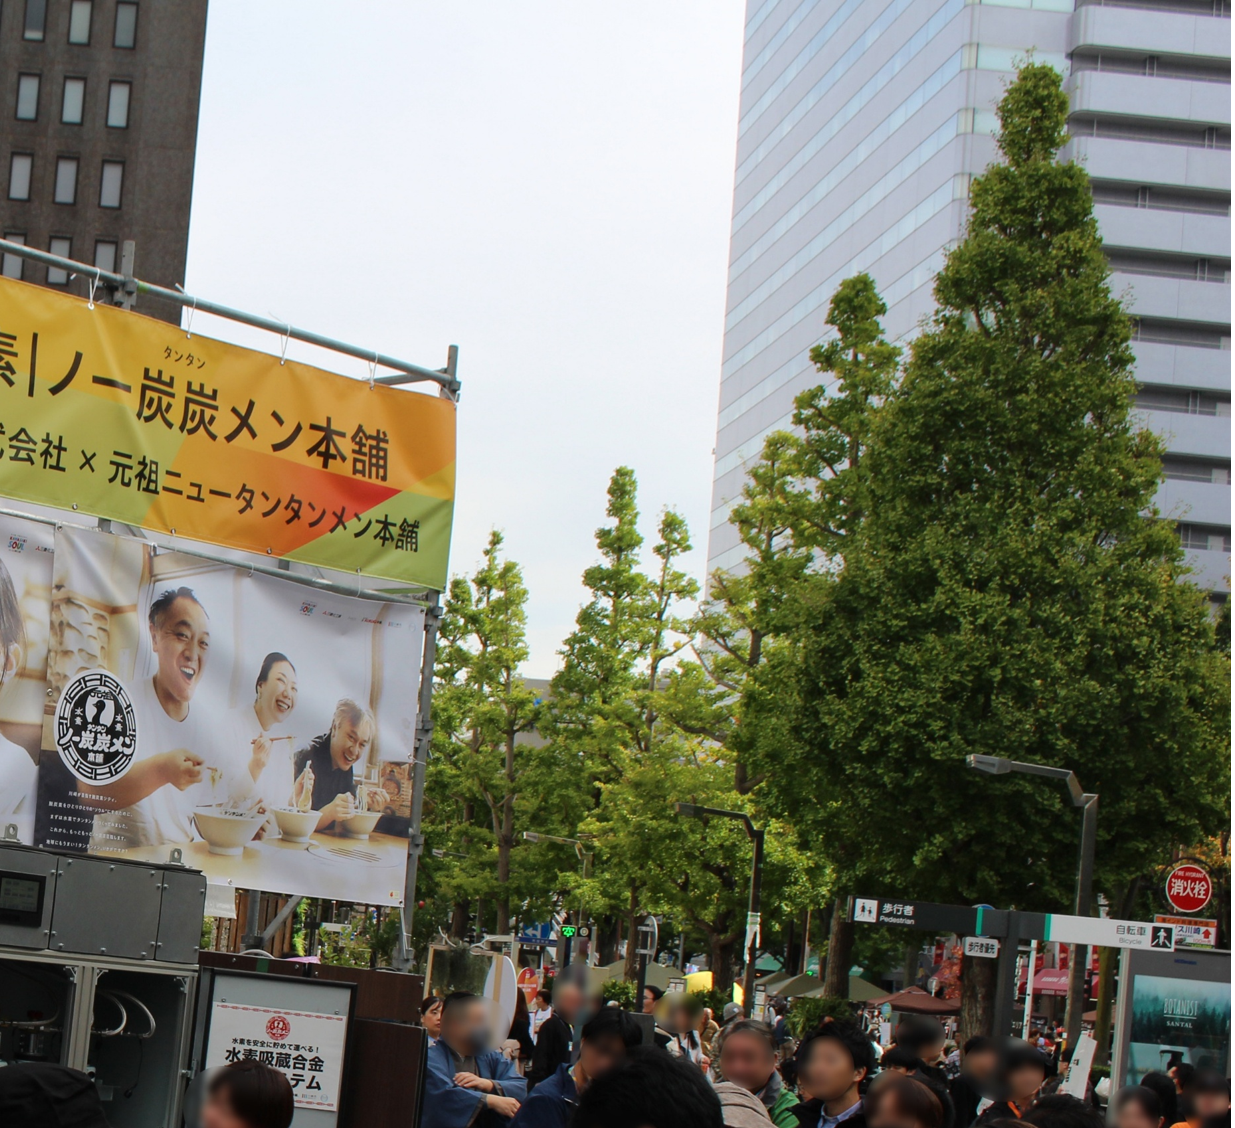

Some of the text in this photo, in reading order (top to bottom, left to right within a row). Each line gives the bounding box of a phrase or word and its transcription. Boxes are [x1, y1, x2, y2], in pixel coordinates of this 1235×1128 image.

[164, 345, 206, 370] タンタン
[108, 450, 421, 553] 元祖ニュータンタンメン本舗
[57, 727, 136, 756] ノー炭炭メン
[1170, 878, 1208, 899] 消火栓
[882, 903, 915, 916] 歩行者
[879, 915, 915, 925] Pedestrian
[1116, 925, 1146, 936] 自転車
[1175, 925, 1201, 935] ス川崎
[1119, 937, 1142, 946] Bicycle
[1164, 998, 1198, 1016] BOTANIST
[1166, 1020, 1193, 1028] SANTAL
[231, 1037, 319, 1053] 水素を安全に貯めて運べる！
[225, 1047, 324, 1072] 水素吸蔵合金
[285, 1073, 322, 1091] テム
